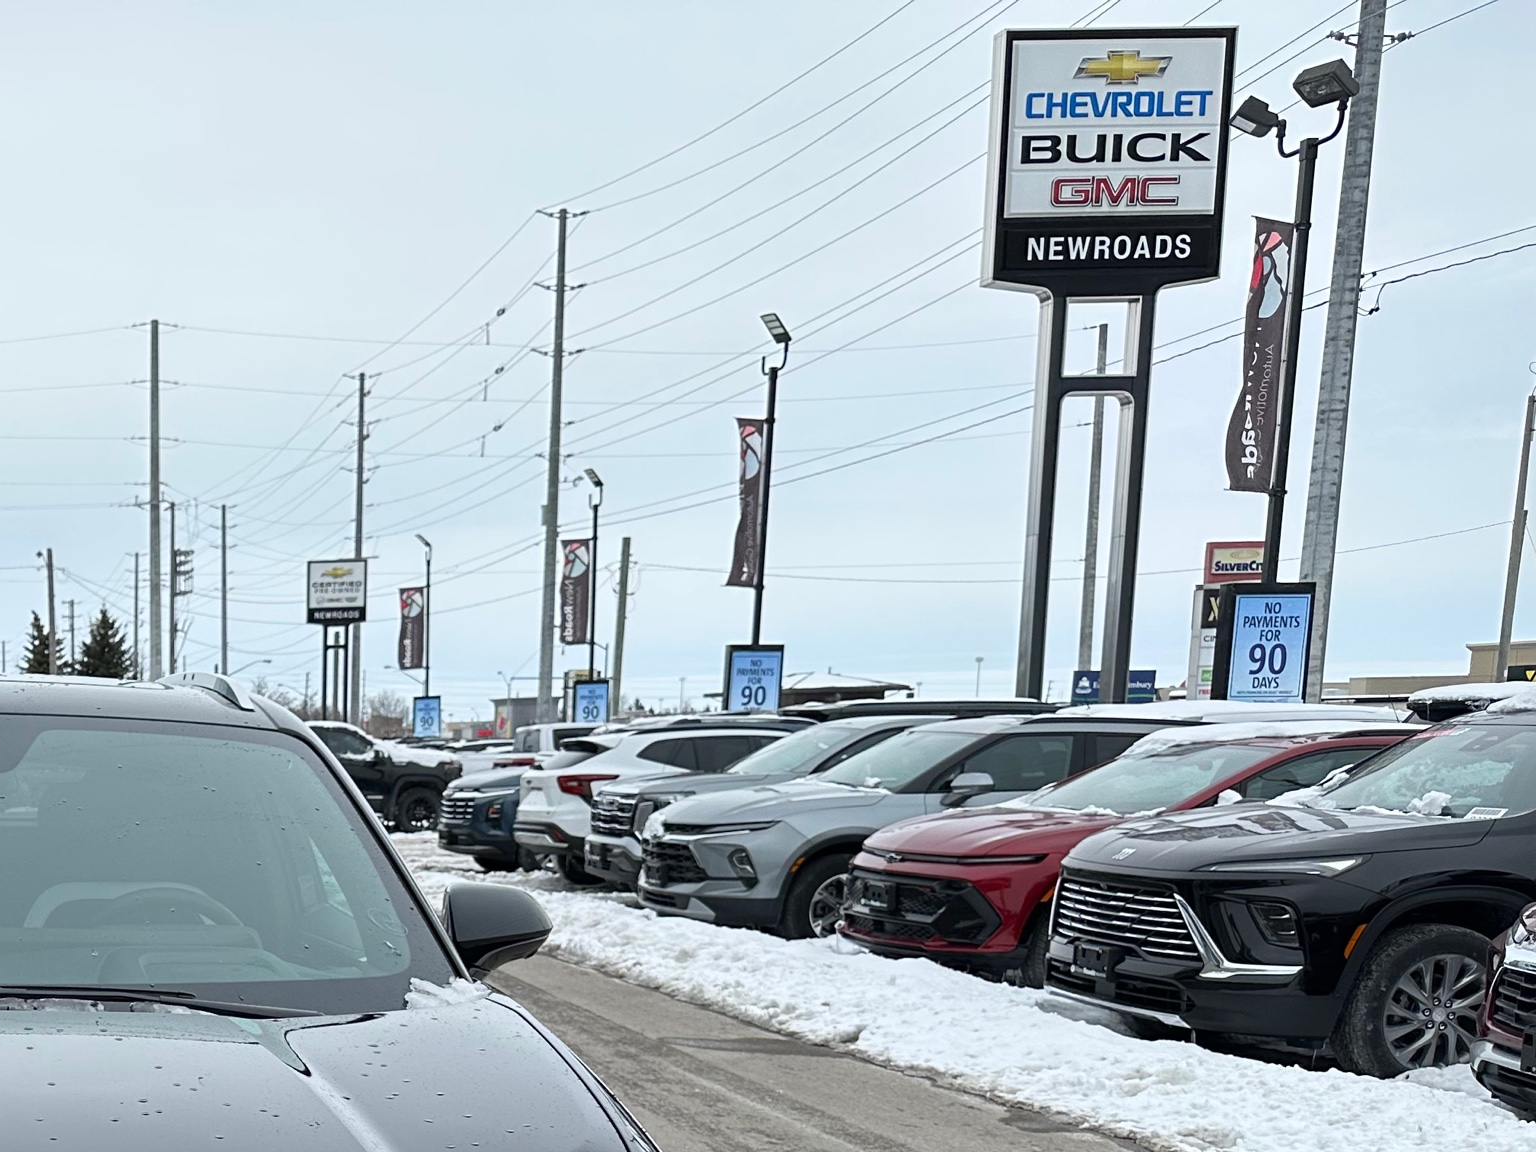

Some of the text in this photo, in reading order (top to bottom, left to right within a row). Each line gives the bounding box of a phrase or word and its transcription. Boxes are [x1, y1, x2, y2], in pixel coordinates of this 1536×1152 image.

[1025, 90, 1214, 119] CHEVROLET
[1020, 132, 1212, 165] BUICK
[1050, 174, 1180, 207] GMC
[1026, 234, 1192, 261] NEWROADS
[1264, 601, 1283, 615] NO
[1242, 615, 1301, 629] PAYMENTS
[1259, 629, 1282, 642] FOR
[1248, 643, 1288, 675] 90
[1251, 676, 1280, 689] DAYS
[741, 685, 767, 706] 90
[582, 705, 600, 720] 90
